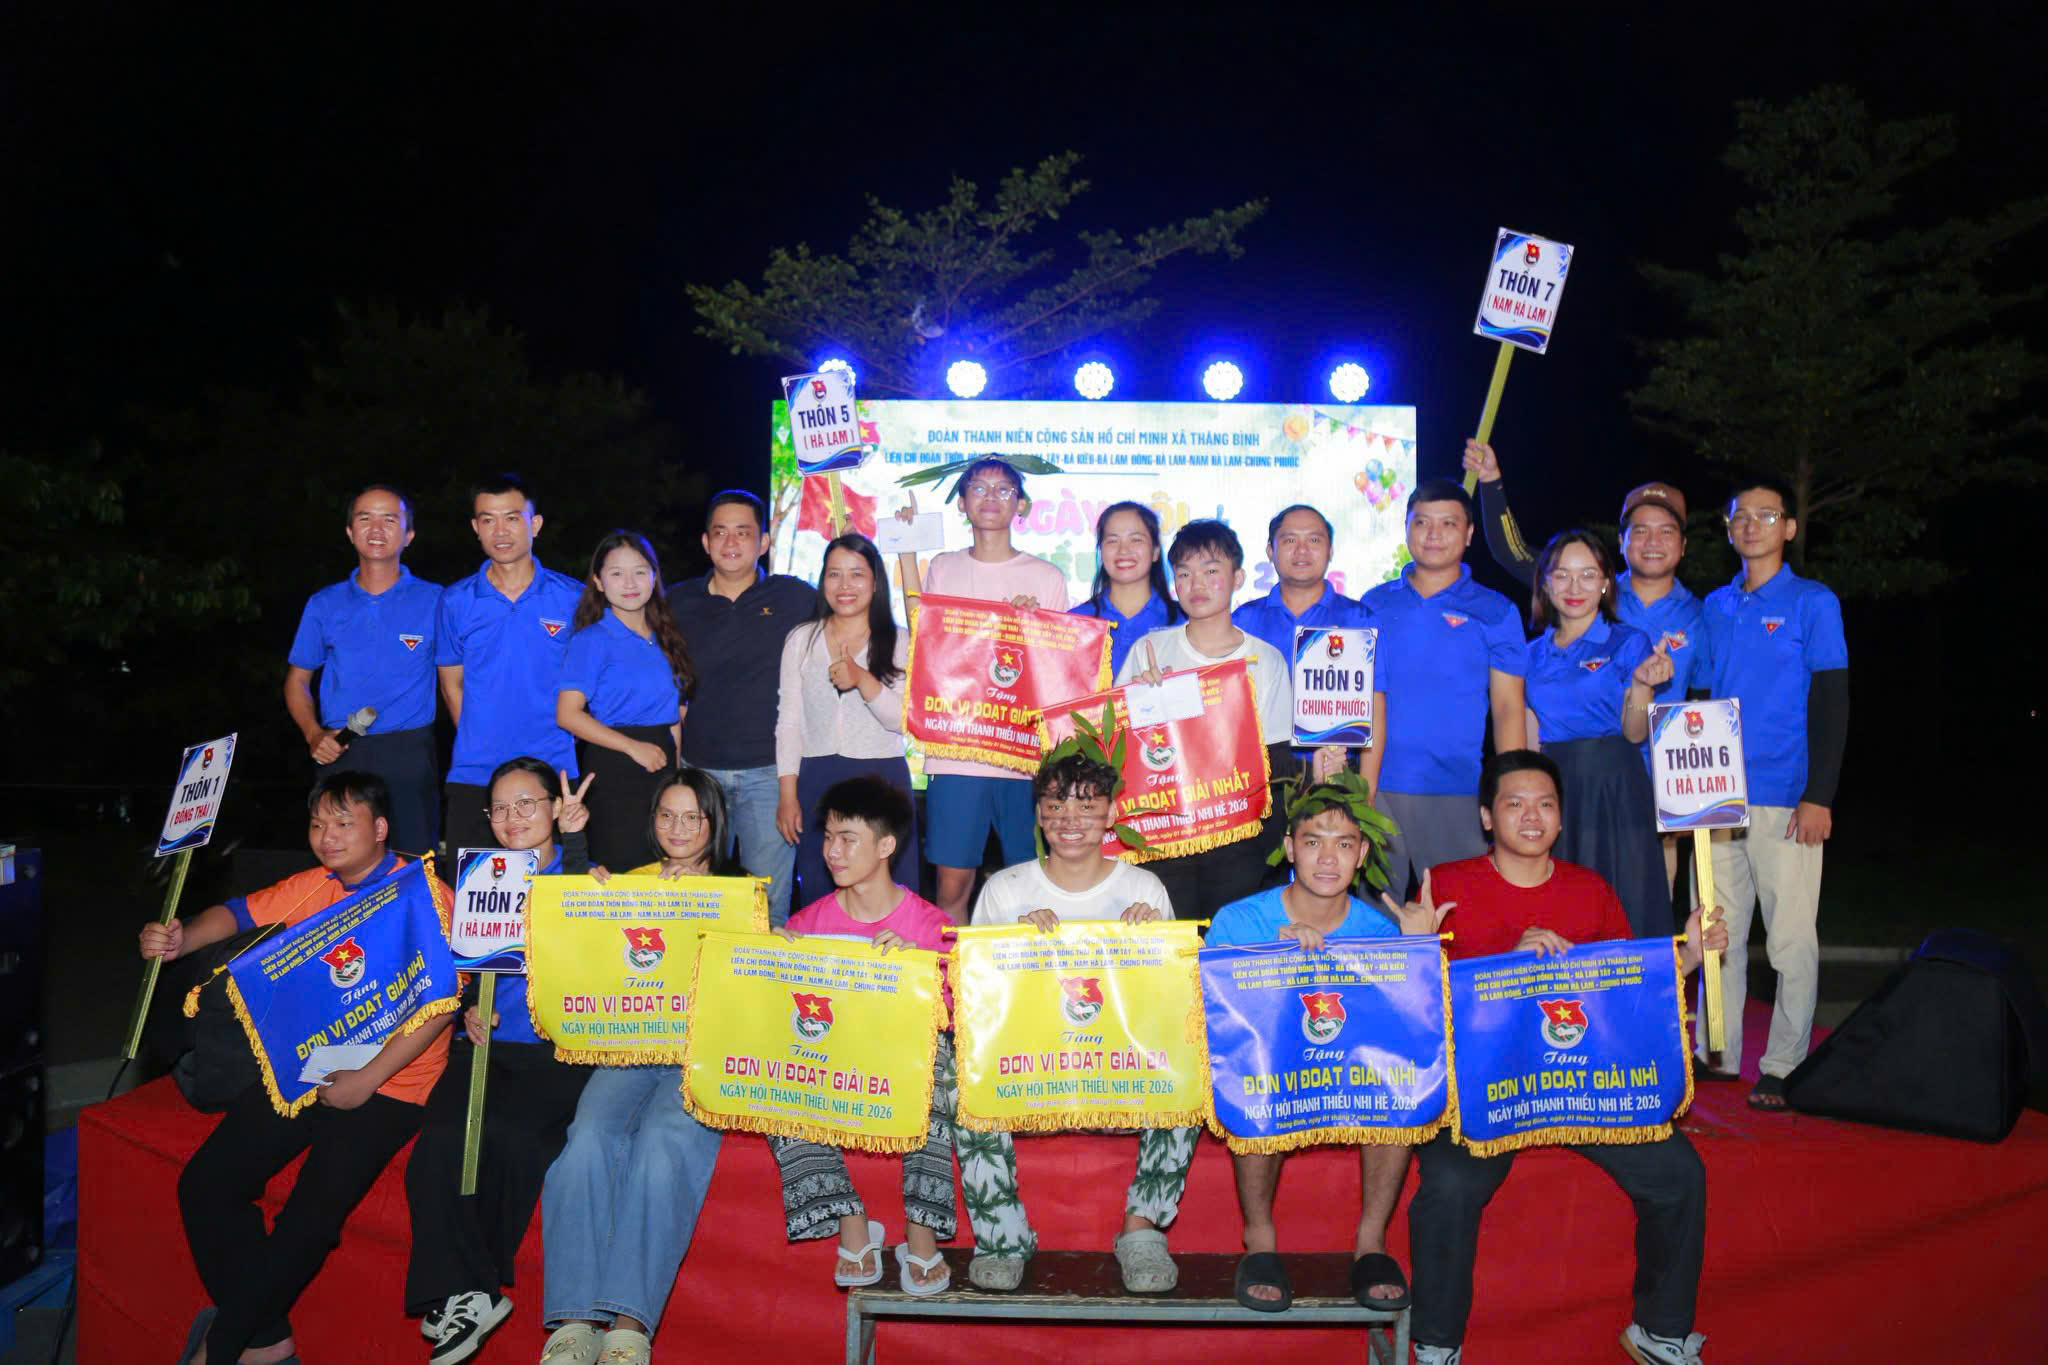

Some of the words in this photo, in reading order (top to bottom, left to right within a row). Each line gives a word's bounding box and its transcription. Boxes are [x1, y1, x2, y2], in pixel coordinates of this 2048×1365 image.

[1499, 269, 1541, 298] THÔN
[1545, 282, 1556, 302] 7
[1493, 295, 1513, 312] NAM
[1527, 304, 1547, 322] LAM
[798, 404, 836, 430] THÔN
[842, 405, 850, 423] 5
[811, 432, 825, 448] HÀ
[827, 430, 848, 446] LAM
[928, 428, 959, 443] ĐOÀN
[964, 430, 1002, 444] THANH
[1006, 428, 1032, 444] NIÊN
[1036, 428, 1067, 447] CỘNG
[1117, 429, 1135, 445] CHÍ
[1139, 431, 1168, 445] MINH
[1232, 431, 1260, 447] BÌNH
[1303, 664, 1349, 692] THÔN
[1354, 670, 1364, 692] 9
[924, 696, 953, 712] ĐƠN
[957, 701, 969, 716] VỊ
[973, 702, 1007, 724] ĐOẠT
[1302, 699, 1333, 716] CHUNG
[1335, 698, 1366, 716] PHƯỚC
[924, 716, 947, 733] NGÀY
[967, 722, 994, 738] THANH
[1016, 732, 1030, 744] NHI
[1665, 743, 1713, 770] THÔN
[1719, 746, 1730, 767] 6
[180, 776, 212, 804] THÔN
[213, 776, 220, 795] 1
[1676, 774, 1694, 795] HÀ
[1698, 775, 1727, 794] LAM
[1138, 789, 1177, 812] ĐOẠT
[1142, 814, 1171, 832] THANH
[1198, 806, 1213, 821] NHI
[1215, 801, 1228, 818] HÈ
[1229, 798, 1248, 815] 2026
[468, 886, 511, 913] THÔN
[515, 892, 526, 913] 2
[465, 918, 477, 937] HÀ
[480, 922, 501, 937] LAM
[505, 920, 522, 938] TÂY
[296, 1030, 329, 1060] ĐƠN
[328, 1018, 347, 1038] VỊ
[344, 992, 383, 1029] ĐOẠT
[385, 971, 409, 1001] GIẢI
[407, 950, 426, 977] NHÌ
[371, 1009, 398, 1033] THIẾU
[414, 975, 432, 996] 2026
[563, 994, 596, 1014] ĐƠN
[602, 996, 616, 1016] VỊ
[622, 994, 665, 1016] ĐOẠT
[607, 1022, 640, 1034] THANH
[672, 1022, 686, 1034] NH
[999, 1054, 1034, 1075] ĐƠN
[1040, 1053, 1055, 1075] VỊ
[1060, 1052, 1104, 1074] ĐOẠT
[1110, 1045, 1141, 1070] GIẢI
[1303, 1047, 1345, 1061] Tặng
[1543, 1051, 1589, 1065] Tặng
[724, 1056, 761, 1077] ĐƠN
[767, 1060, 781, 1083] VỊ
[785, 1063, 827, 1091] ĐOẠT
[833, 1067, 863, 1094] GIẢI
[868, 1076, 891, 1096] BA
[996, 1080, 1023, 1099] NGÀY
[1026, 1078, 1044, 1098] HỘI
[1046, 1080, 1078, 1095] THANH
[1081, 1074, 1108, 1094] THIẾU
[1112, 1080, 1129, 1094] NHI
[1149, 1079, 1174, 1094] 2026
[1284, 1071, 1298, 1096] VỊ
[1300, 1067, 1343, 1092] ĐOẠT
[1387, 1059, 1416, 1086] NHÌ
[1487, 1079, 1519, 1103] ĐƠN
[1523, 1073, 1537, 1095] VỊ
[1541, 1070, 1587, 1093] ĐOẠT
[1593, 1062, 1626, 1089] GIẢI
[1630, 1059, 1658, 1087] NHÌ
[720, 1082, 748, 1099] NGÀY
[750, 1083, 767, 1102] HỘI
[770, 1087, 801, 1105] THANH
[804, 1089, 830, 1110] THIẾU
[832, 1100, 848, 1113] NHI
[868, 1105, 892, 1119] 2026
[1276, 1098, 1291, 1120] HỘI
[1293, 1096, 1321, 1116] THANH
[1323, 1090, 1351, 1110] THIẾU
[1353, 1095, 1372, 1110] NHI
[1375, 1092, 1389, 1110] HÈ
[1392, 1095, 1418, 1110] 2026
[1488, 1106, 1513, 1125] NGÀY
[1514, 1101, 1530, 1119] HỘI
[1531, 1098, 1564, 1113] THANH
[1567, 1092, 1596, 1111] THIẾU
[1598, 1098, 1617, 1112] NHI
[1620, 1094, 1633, 1111] HÈ
[1636, 1095, 1661, 1110] 2026
